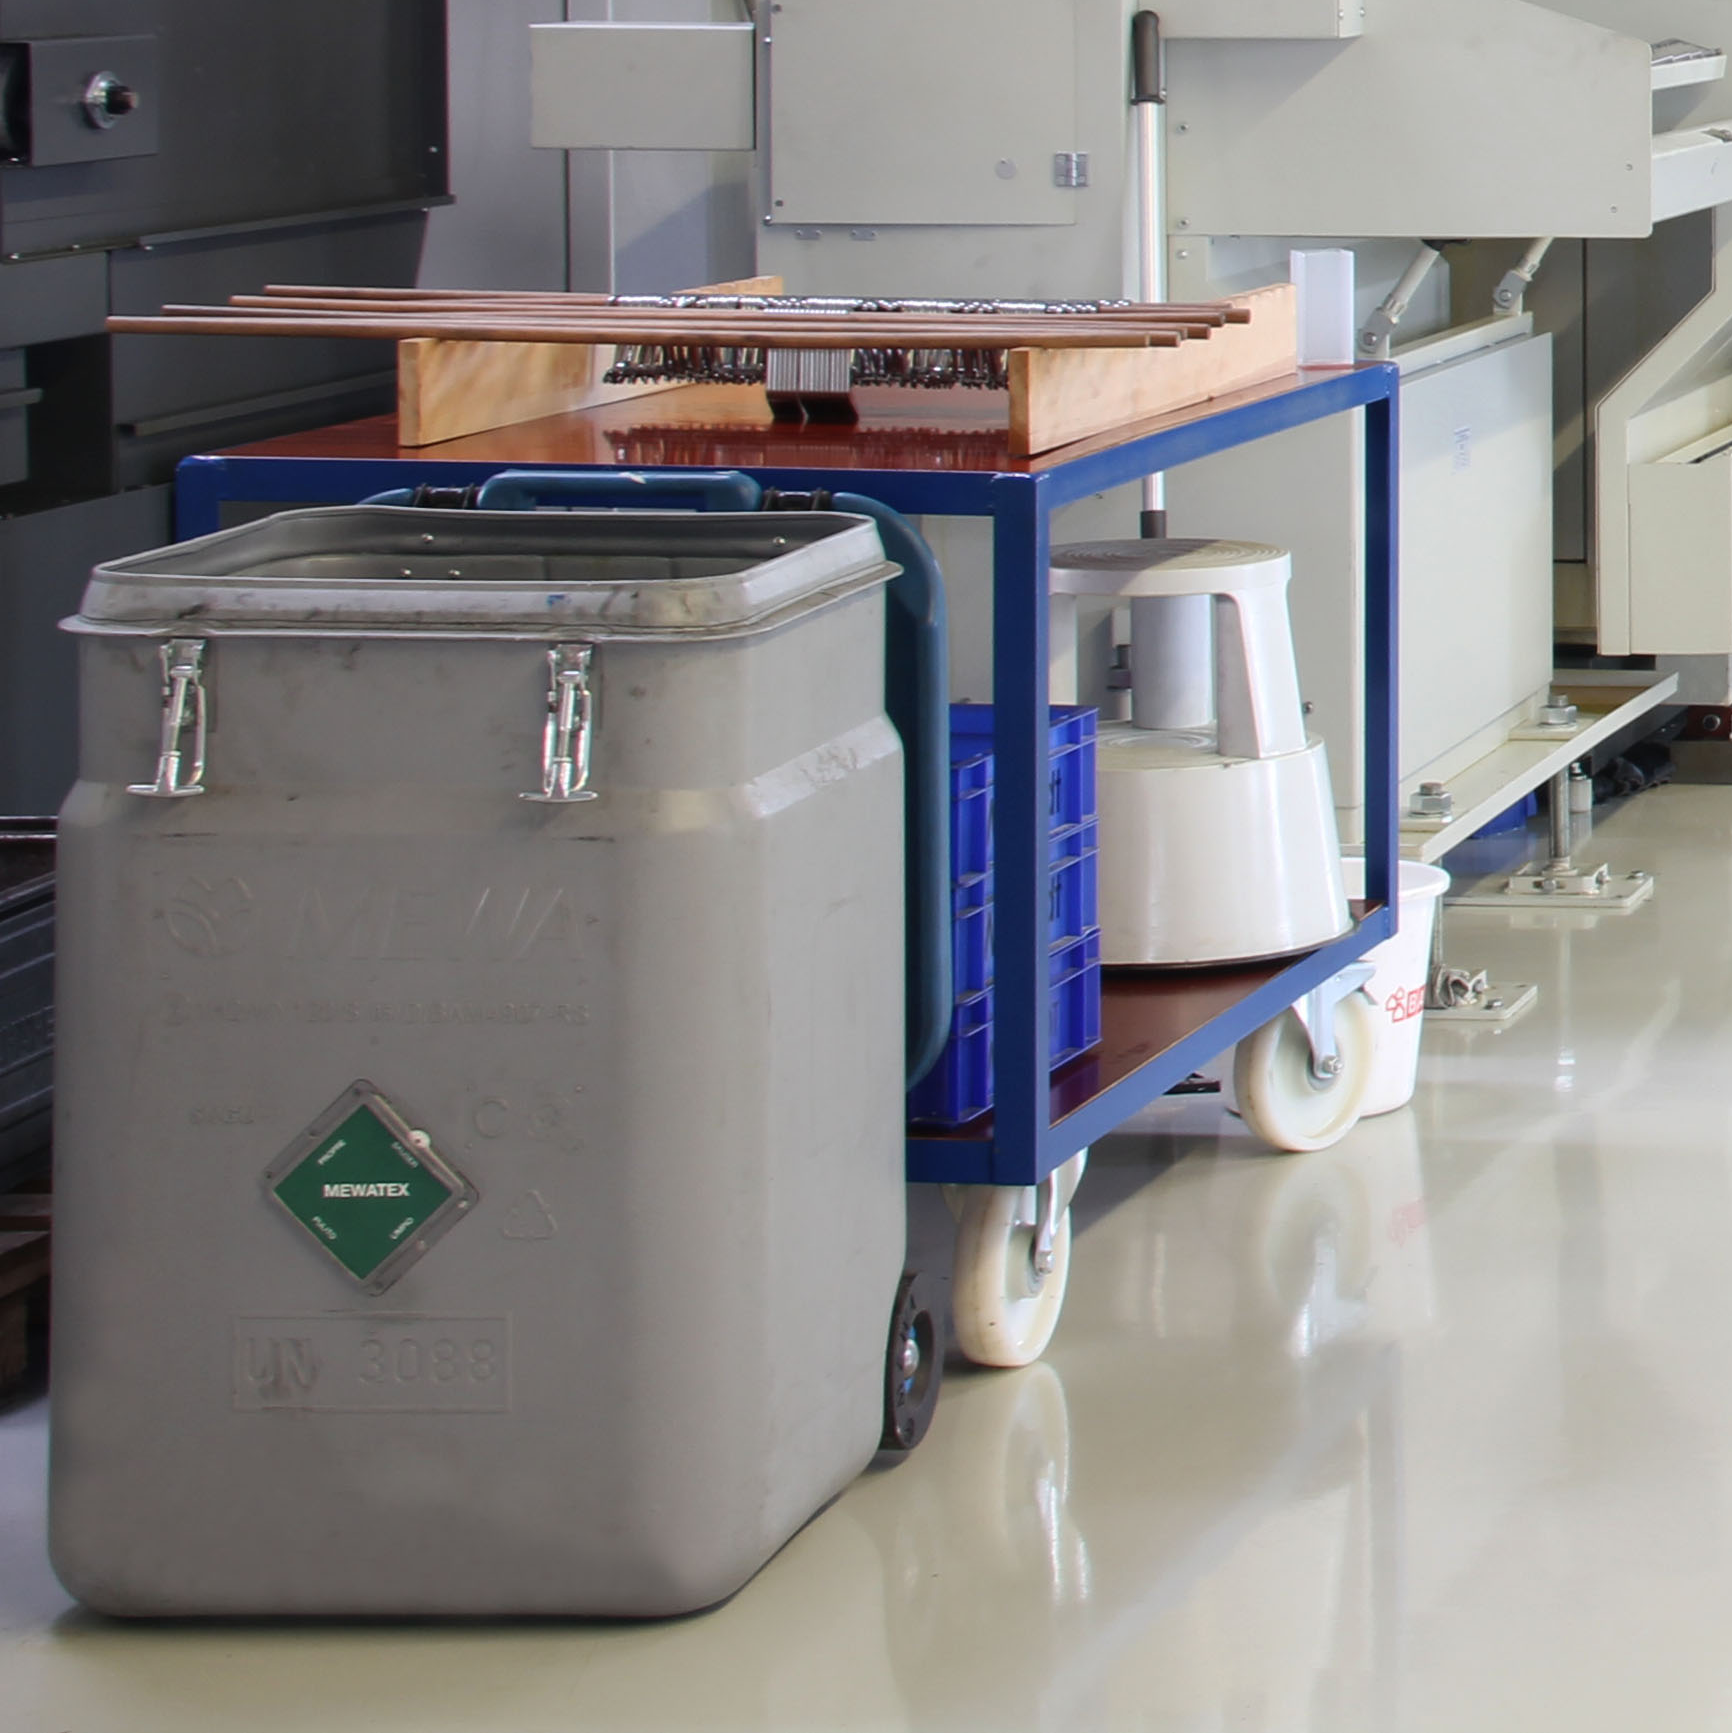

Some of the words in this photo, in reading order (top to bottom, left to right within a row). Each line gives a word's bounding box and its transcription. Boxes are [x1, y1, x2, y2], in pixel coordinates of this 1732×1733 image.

[323, 1183, 410, 1198] MEWATEX
[247, 1336, 319, 1387] UN
[358, 1336, 498, 1383] 3088
